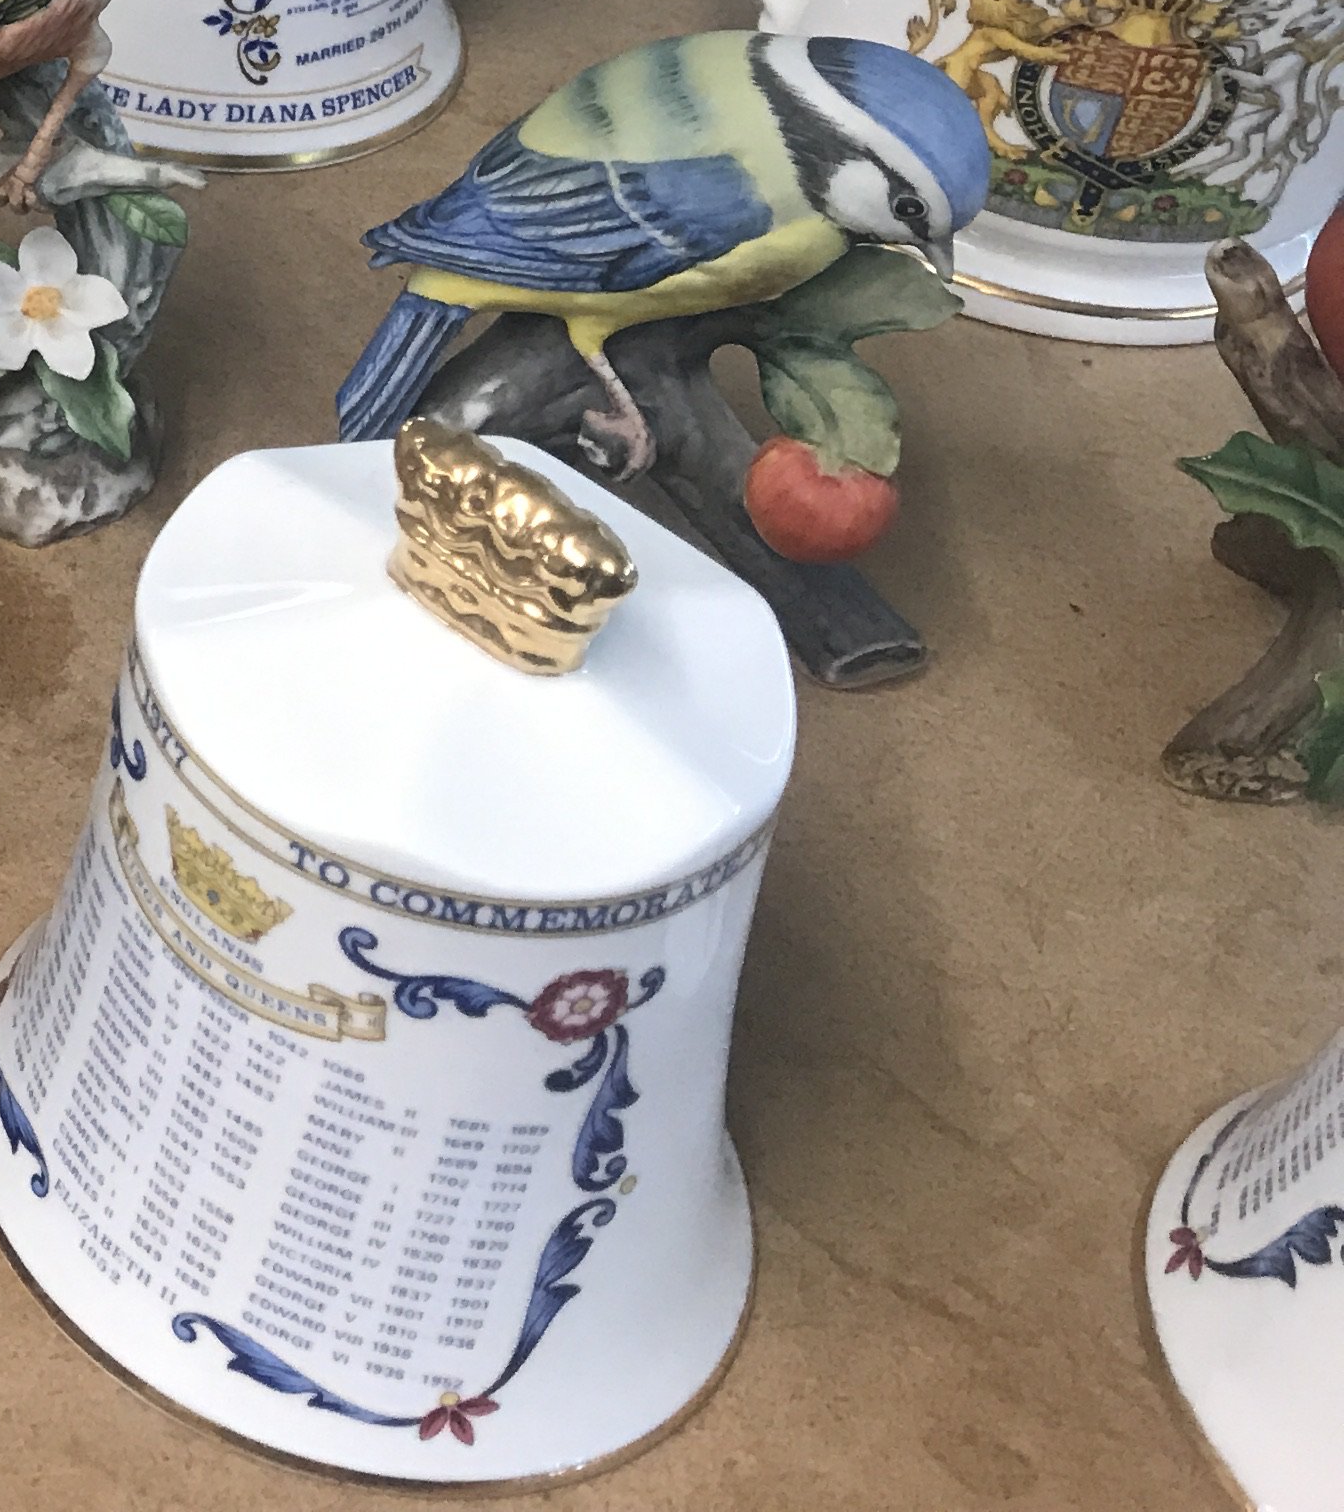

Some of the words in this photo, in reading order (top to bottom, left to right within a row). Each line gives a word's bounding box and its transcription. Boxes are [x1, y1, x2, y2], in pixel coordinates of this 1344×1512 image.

[296, 36, 365, 67] MARRIED
[136, 91, 216, 123] LADY
[225, 102, 316, 124] DIANA
[321, 64, 418, 118] SPENCER
[289, 840, 350, 889] TO
